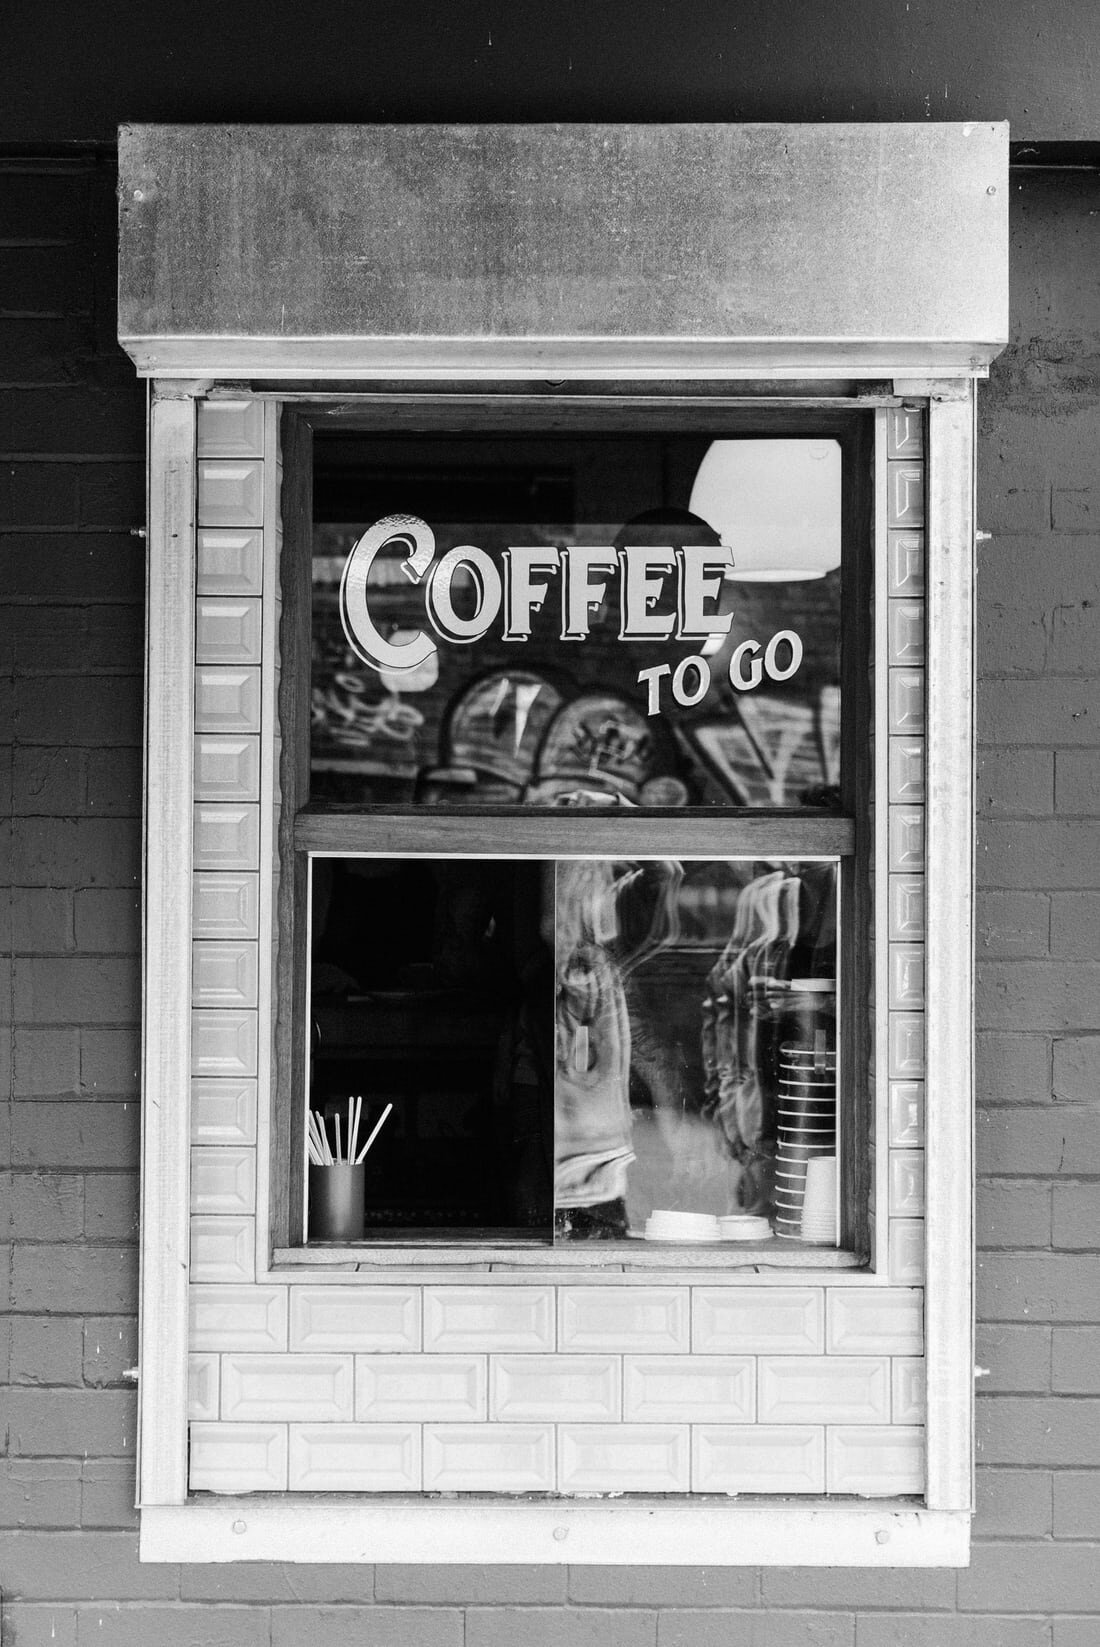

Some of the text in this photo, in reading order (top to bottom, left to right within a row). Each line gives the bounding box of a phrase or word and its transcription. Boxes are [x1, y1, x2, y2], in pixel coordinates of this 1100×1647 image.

[339, 513, 735, 675] COFFEE
[637, 630, 803, 716] TO GO
